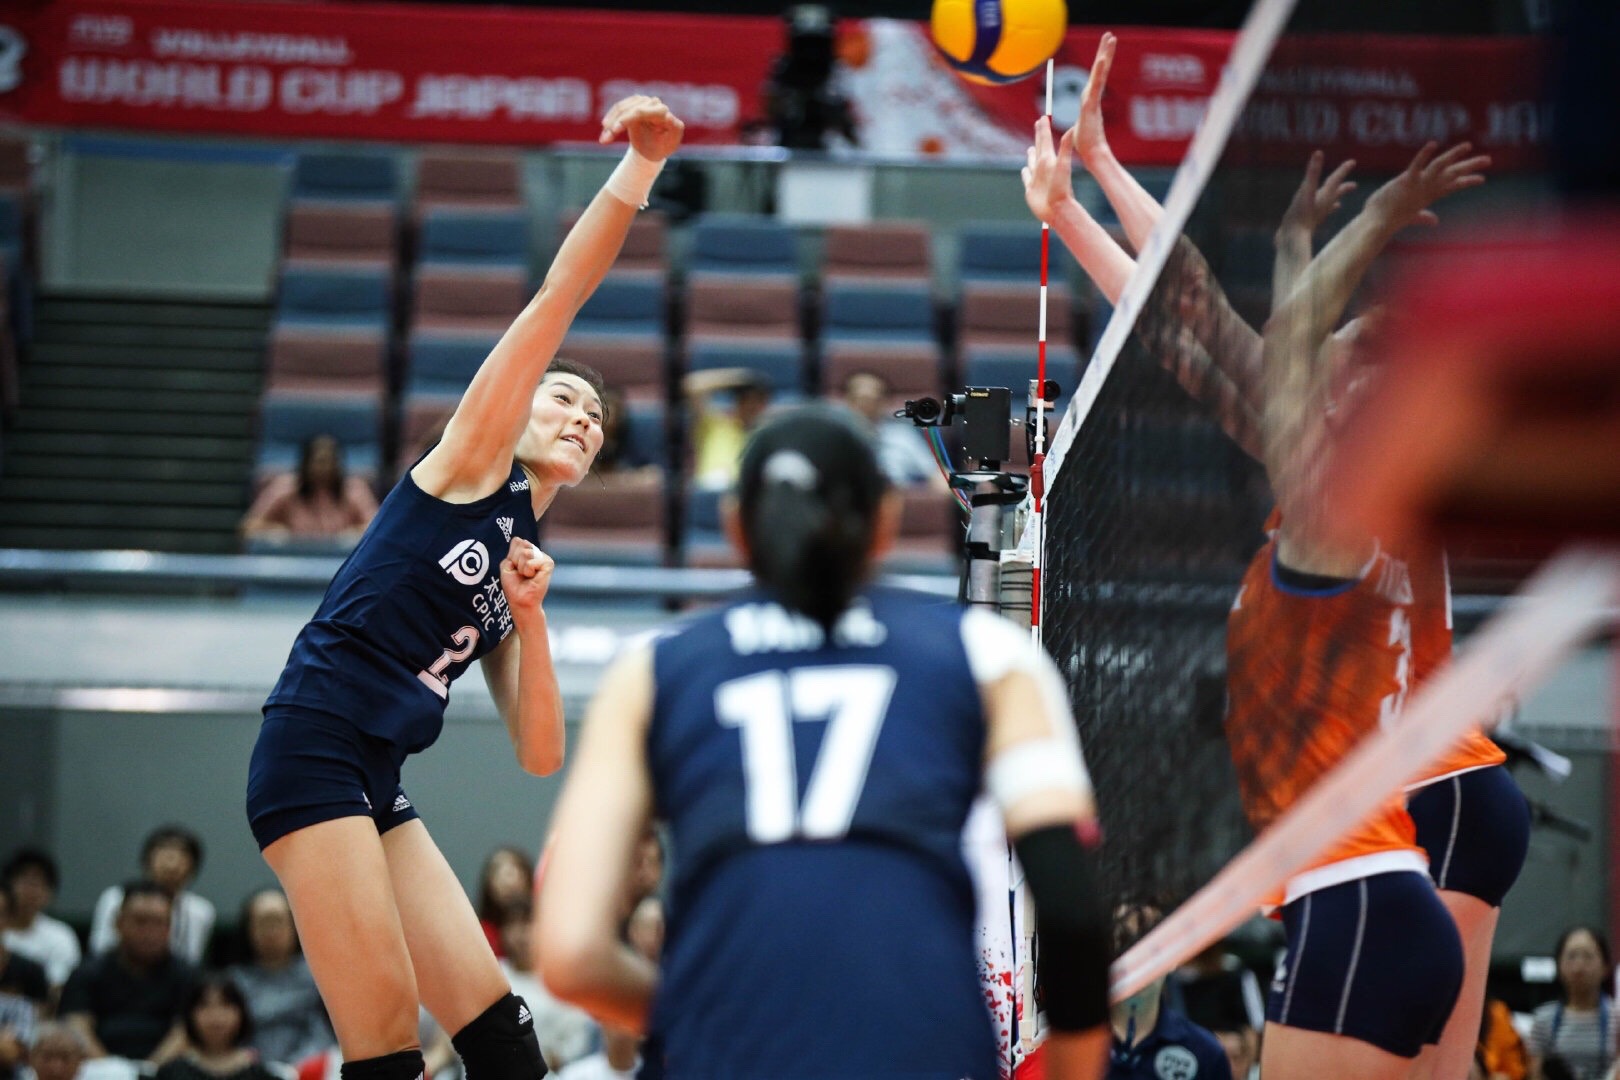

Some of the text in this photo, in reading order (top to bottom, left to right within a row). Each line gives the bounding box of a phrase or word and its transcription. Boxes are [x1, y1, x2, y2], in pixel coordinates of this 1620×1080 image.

[60, 57, 272, 111] WORLD
[279, 68, 401, 114] CUP
[407, 75, 592, 122] JAPAN
[472, 593, 495, 631] CPIC
[416, 625, 480, 700] 2
[714, 664, 897, 843] 17
